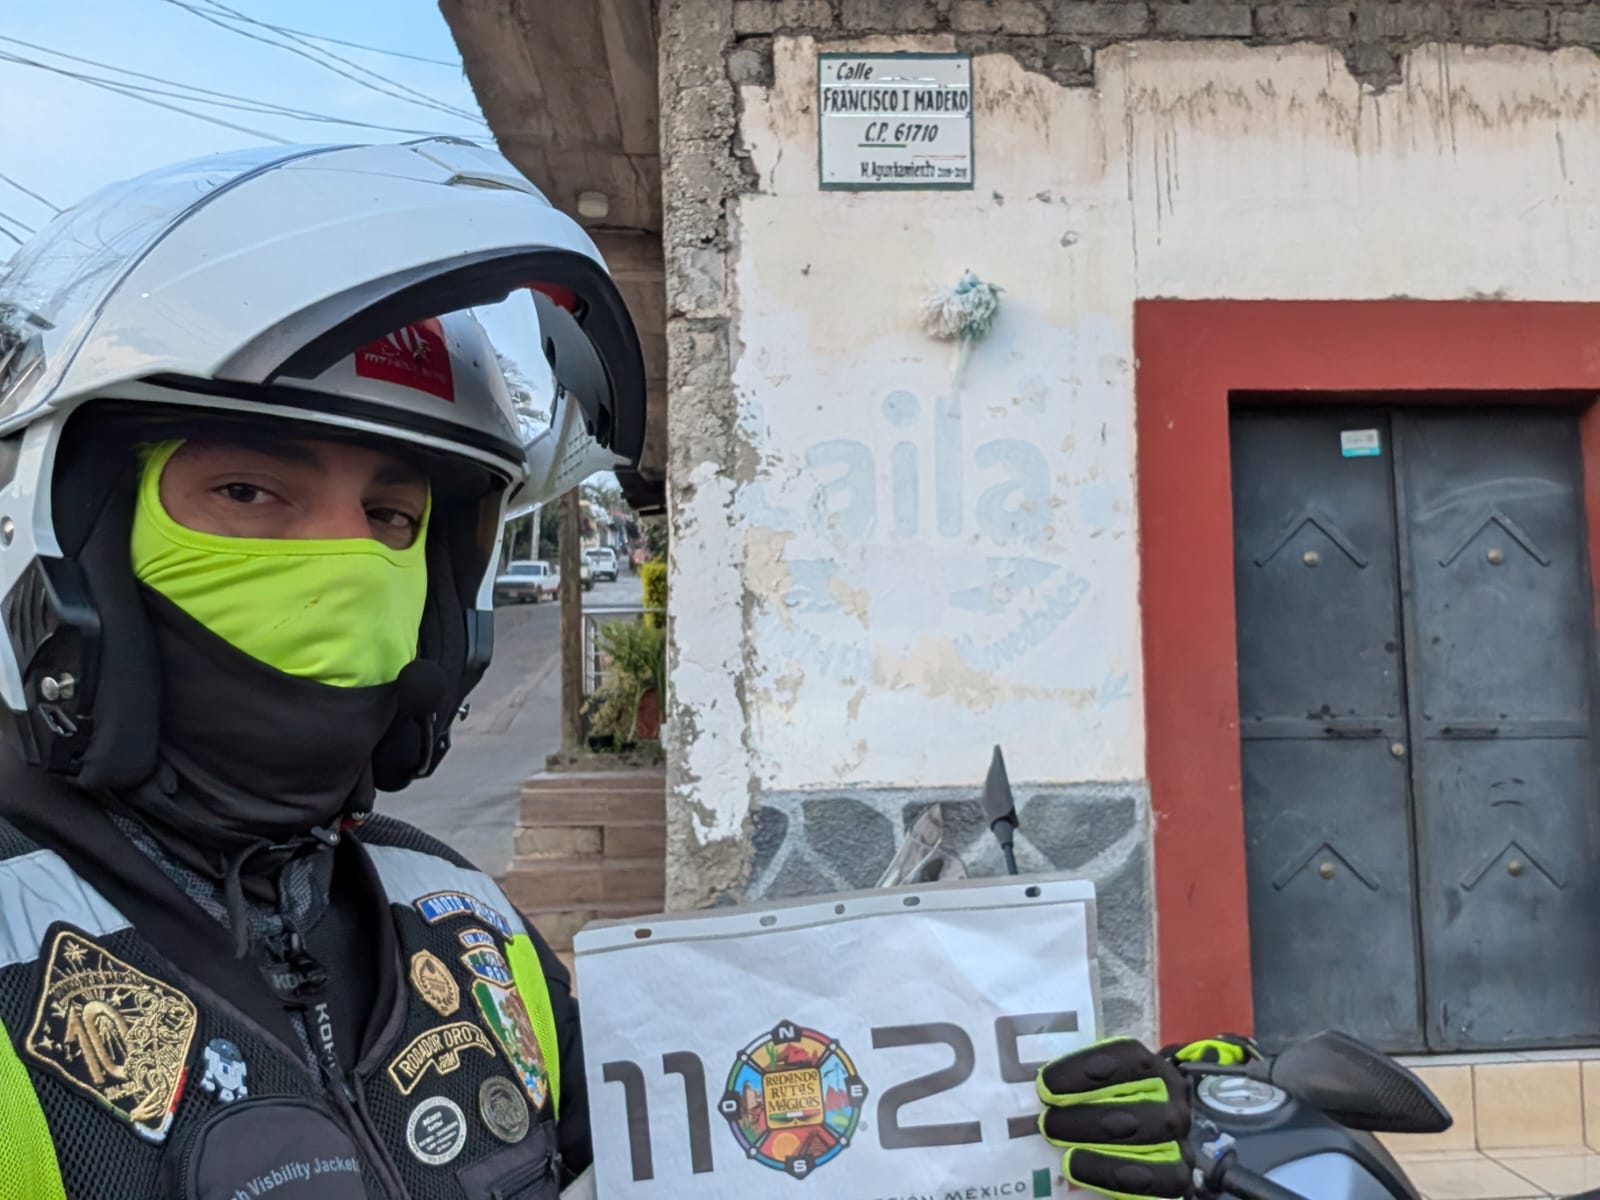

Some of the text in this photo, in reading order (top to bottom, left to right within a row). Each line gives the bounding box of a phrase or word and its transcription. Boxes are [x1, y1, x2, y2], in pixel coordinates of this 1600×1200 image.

[836, 62, 873, 80] Calle
[823, 88, 968, 112] FRANCISCO I MADERO
[894, 122, 939, 142] 61710
[778, 1025, 795, 1039] N
[399, 1034, 444, 1078] RODADOR
[443, 1025, 473, 1048] ORO
[850, 1084, 864, 1097] E
[792, 1159, 808, 1173] S
